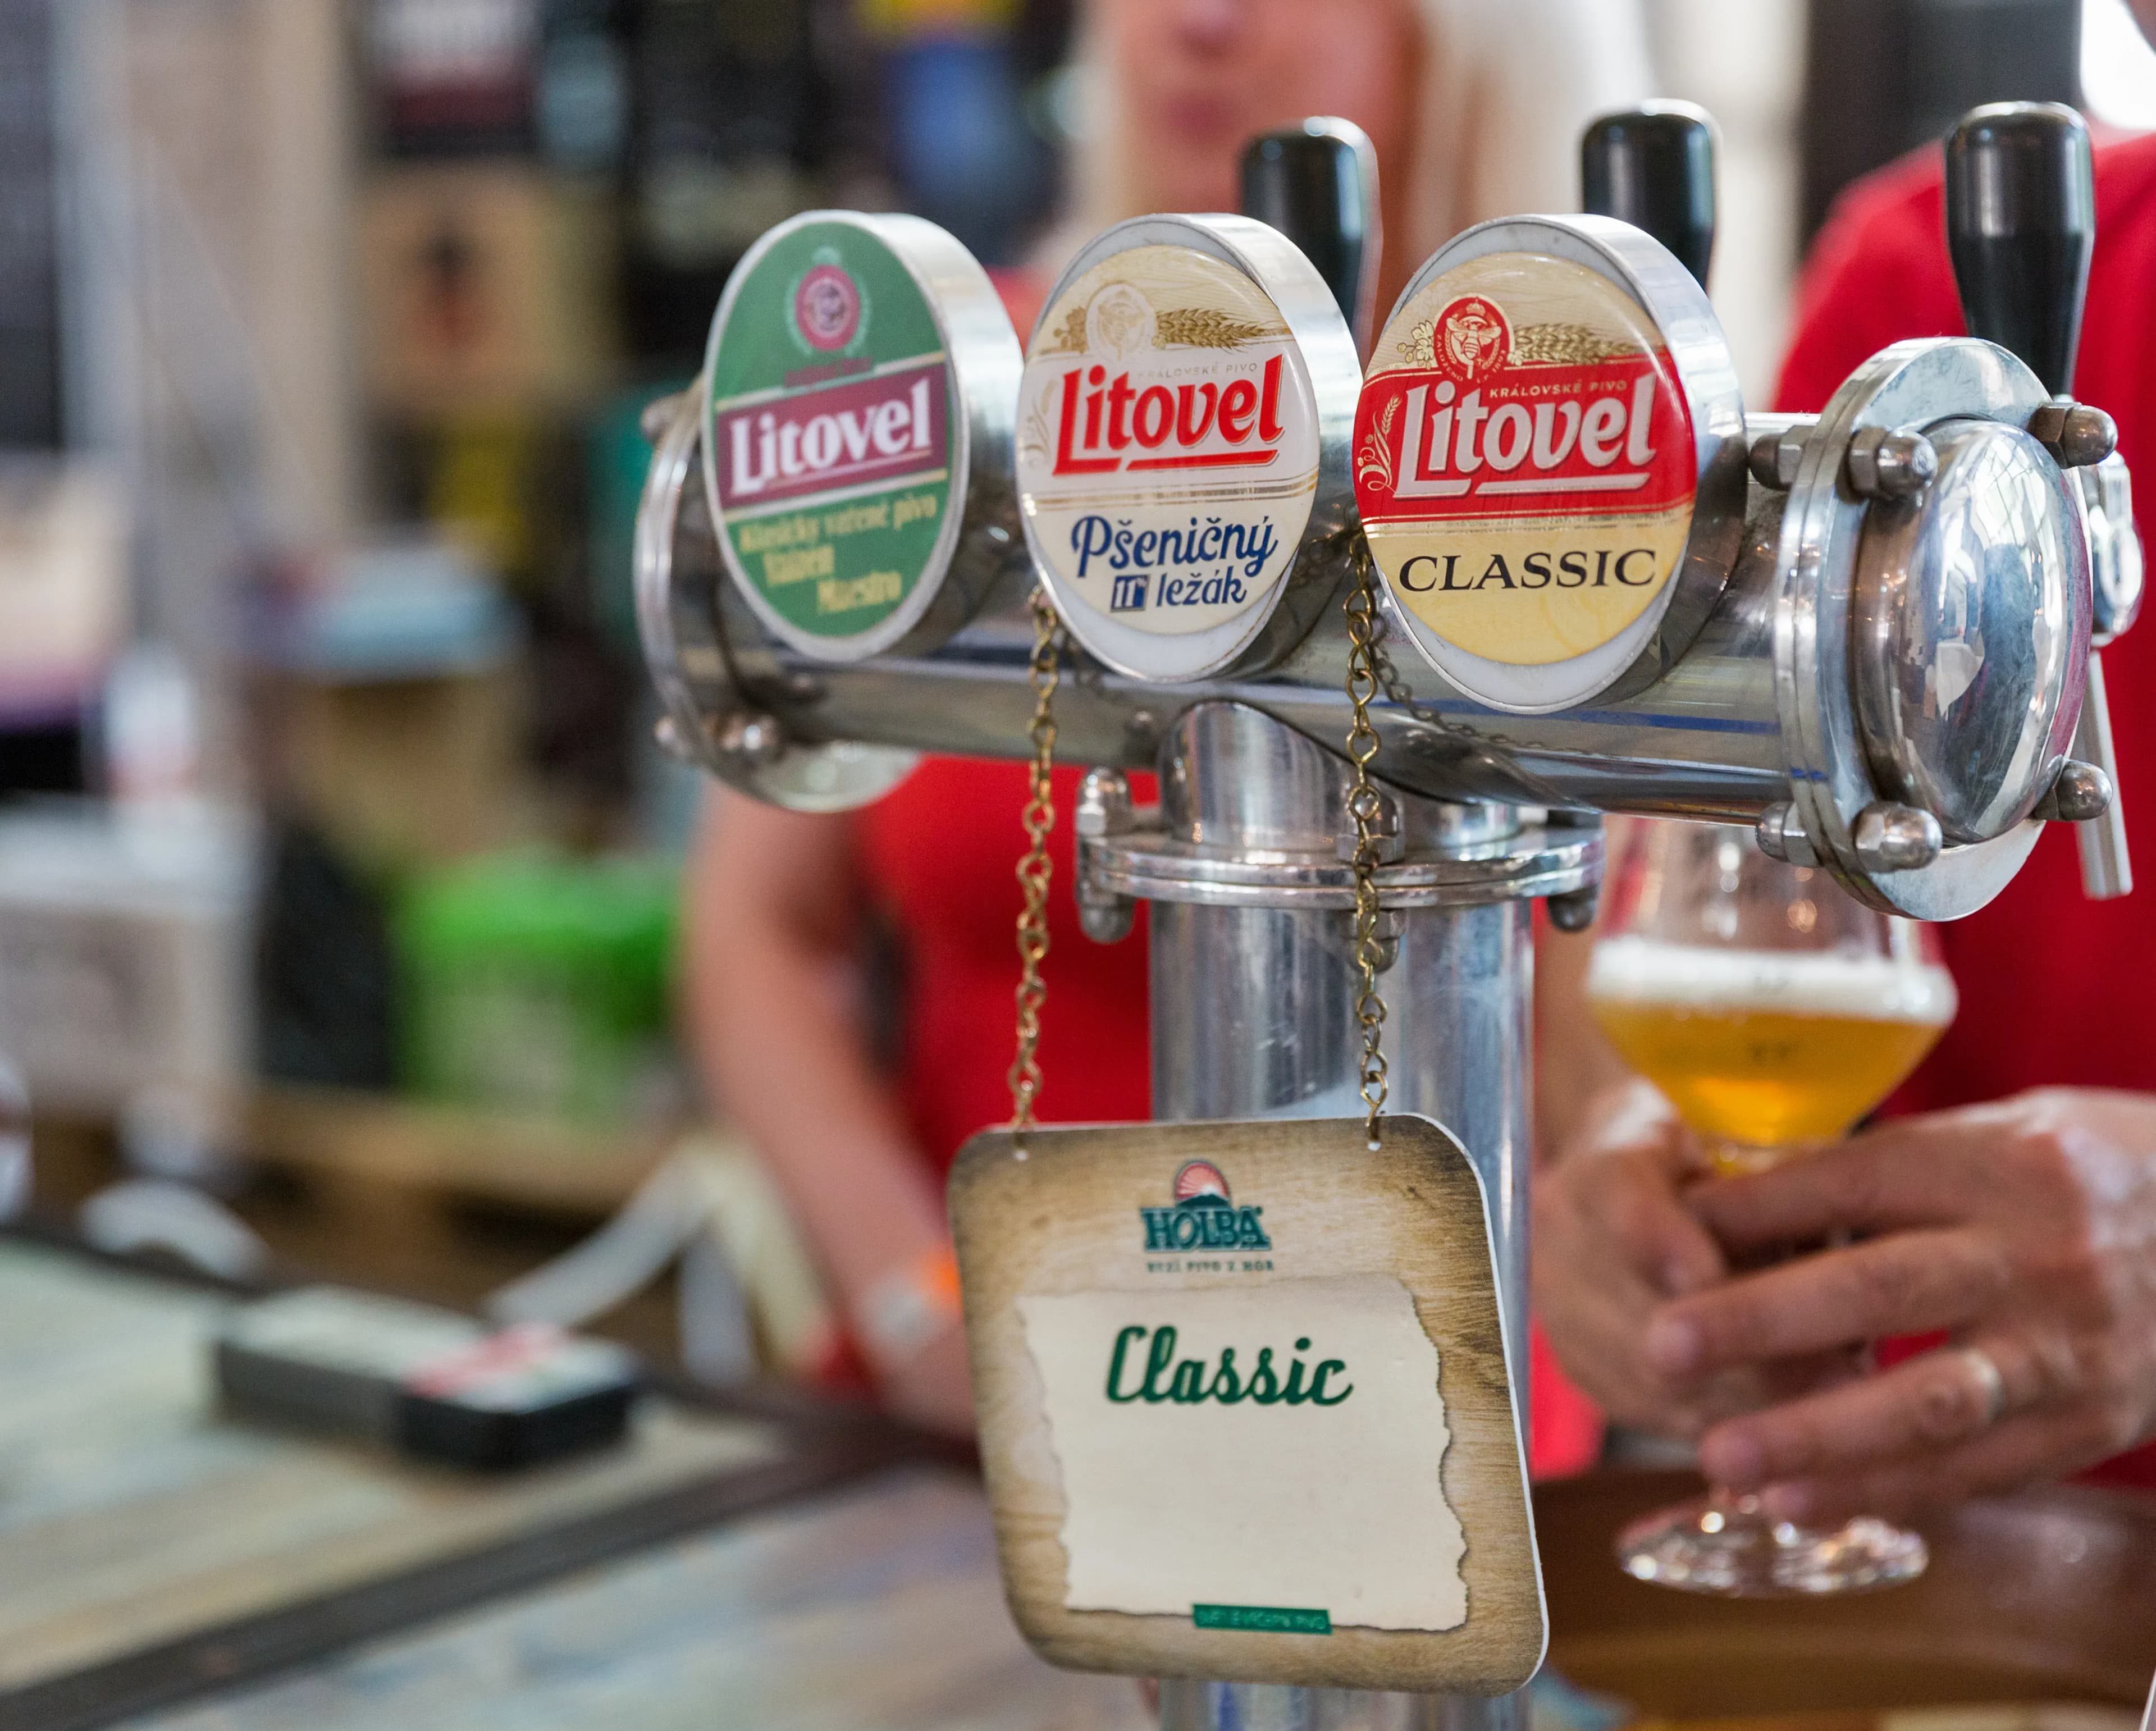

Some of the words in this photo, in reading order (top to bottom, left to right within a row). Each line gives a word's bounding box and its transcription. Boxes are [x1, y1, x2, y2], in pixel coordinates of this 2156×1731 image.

[1226, 362, 1258, 373] PIVO
[1490, 378, 1582, 398] KRÁLOVSKÉ
[1589, 380, 1628, 392] PIVO
[729, 376, 931, 496] Litovel
[1052, 353, 1285, 477] Litovel
[1394, 372, 1657, 500] Litovel
[1071, 514, 1279, 578] Pšeničný
[1398, 549, 1656, 592] CLASSIC
[1155, 565, 1248, 608] ležák
[1140, 1205, 1272, 1253] HOLBA
[1106, 1325, 1354, 1406] Classic
